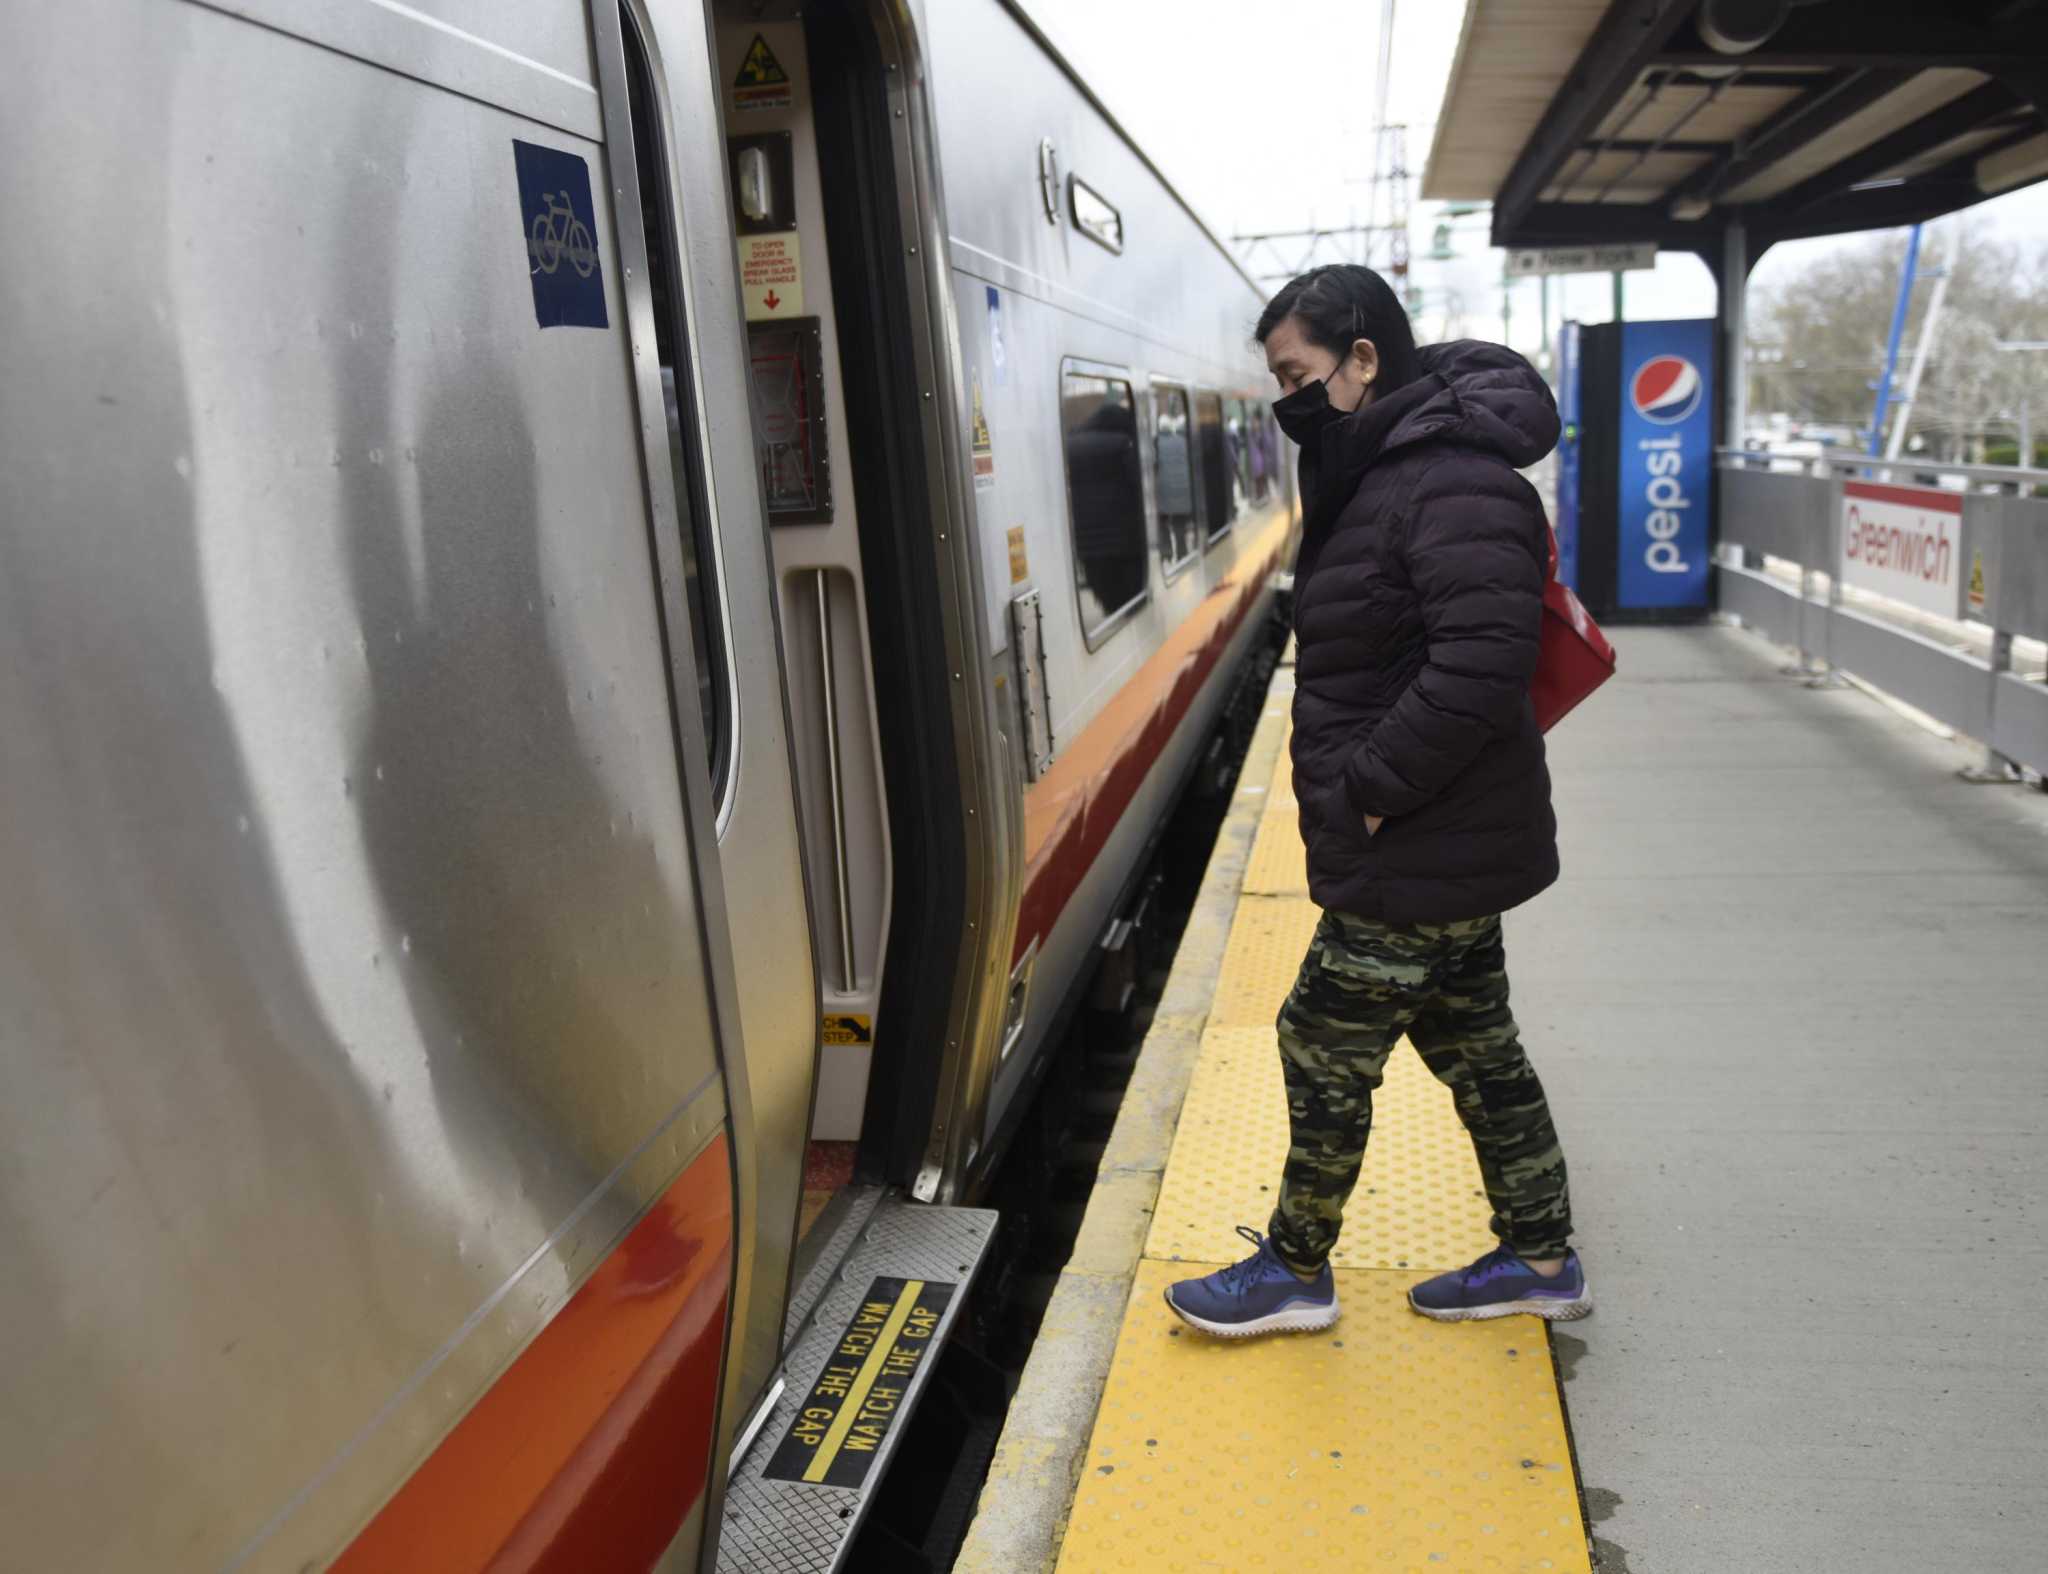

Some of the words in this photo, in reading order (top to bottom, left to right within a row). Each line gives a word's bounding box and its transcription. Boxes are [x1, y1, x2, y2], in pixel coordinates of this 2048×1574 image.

[752, 250, 776, 258] DOOR
[764, 240, 784, 248] OPEN
[745, 258, 793, 269] EMERGENCY
[766, 274, 796, 283] HANDLE
[771, 265, 796, 275] GLASS
[1638, 432, 1690, 573] pepsi
[1847, 504, 1951, 585] Greenwich
[839, 1302, 891, 1355] WATCH
[816, 1367, 857, 1398] THE
[844, 1387, 901, 1451] WATCH
[882, 1346, 921, 1376] THE
[903, 1307, 939, 1338] GAP
[792, 1407, 833, 1446] GAP
